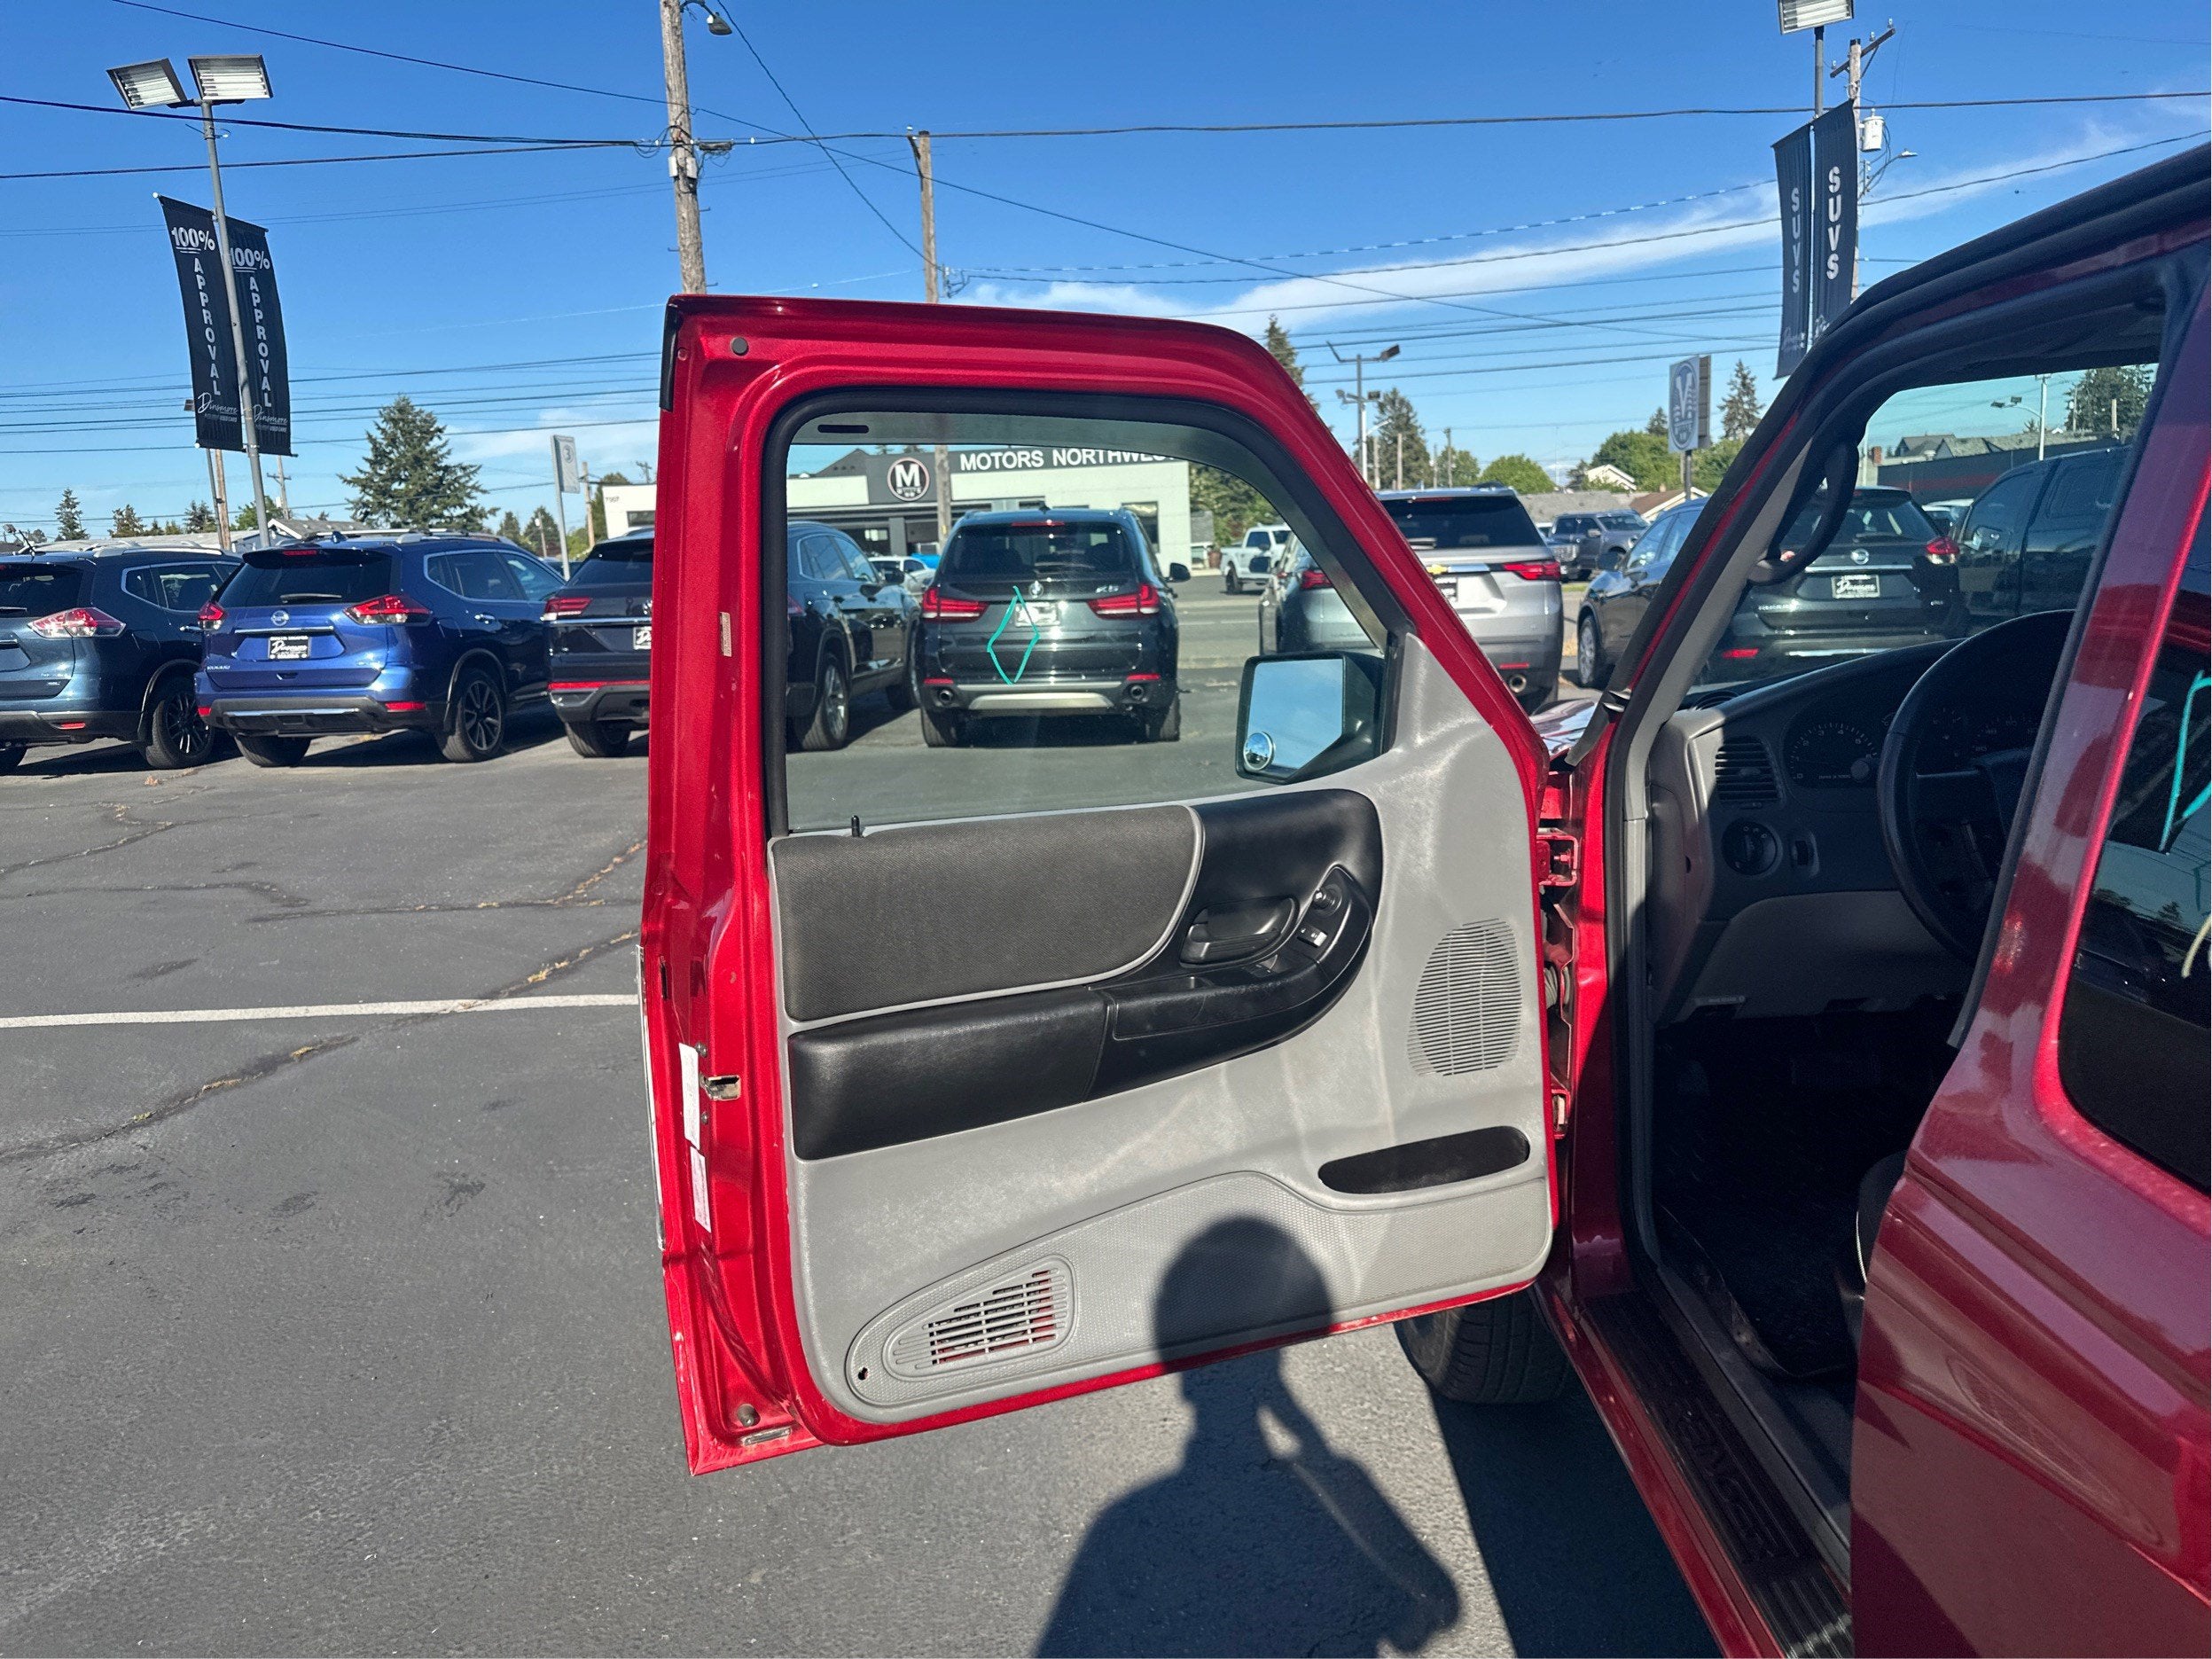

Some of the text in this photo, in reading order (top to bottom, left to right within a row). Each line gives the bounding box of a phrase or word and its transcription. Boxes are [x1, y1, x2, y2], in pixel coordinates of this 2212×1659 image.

[171, 227, 215, 251] 100%
[1791, 187, 1801, 293] SUVS
[1827, 166, 1841, 280] SUVS
[230, 247, 270, 270] 100%
[194, 258, 221, 395] APPROVAL
[249, 277, 272, 407] APPROVAL
[895, 464, 921, 488] M
[960, 448, 1175, 471] MOTORS NORTHW
